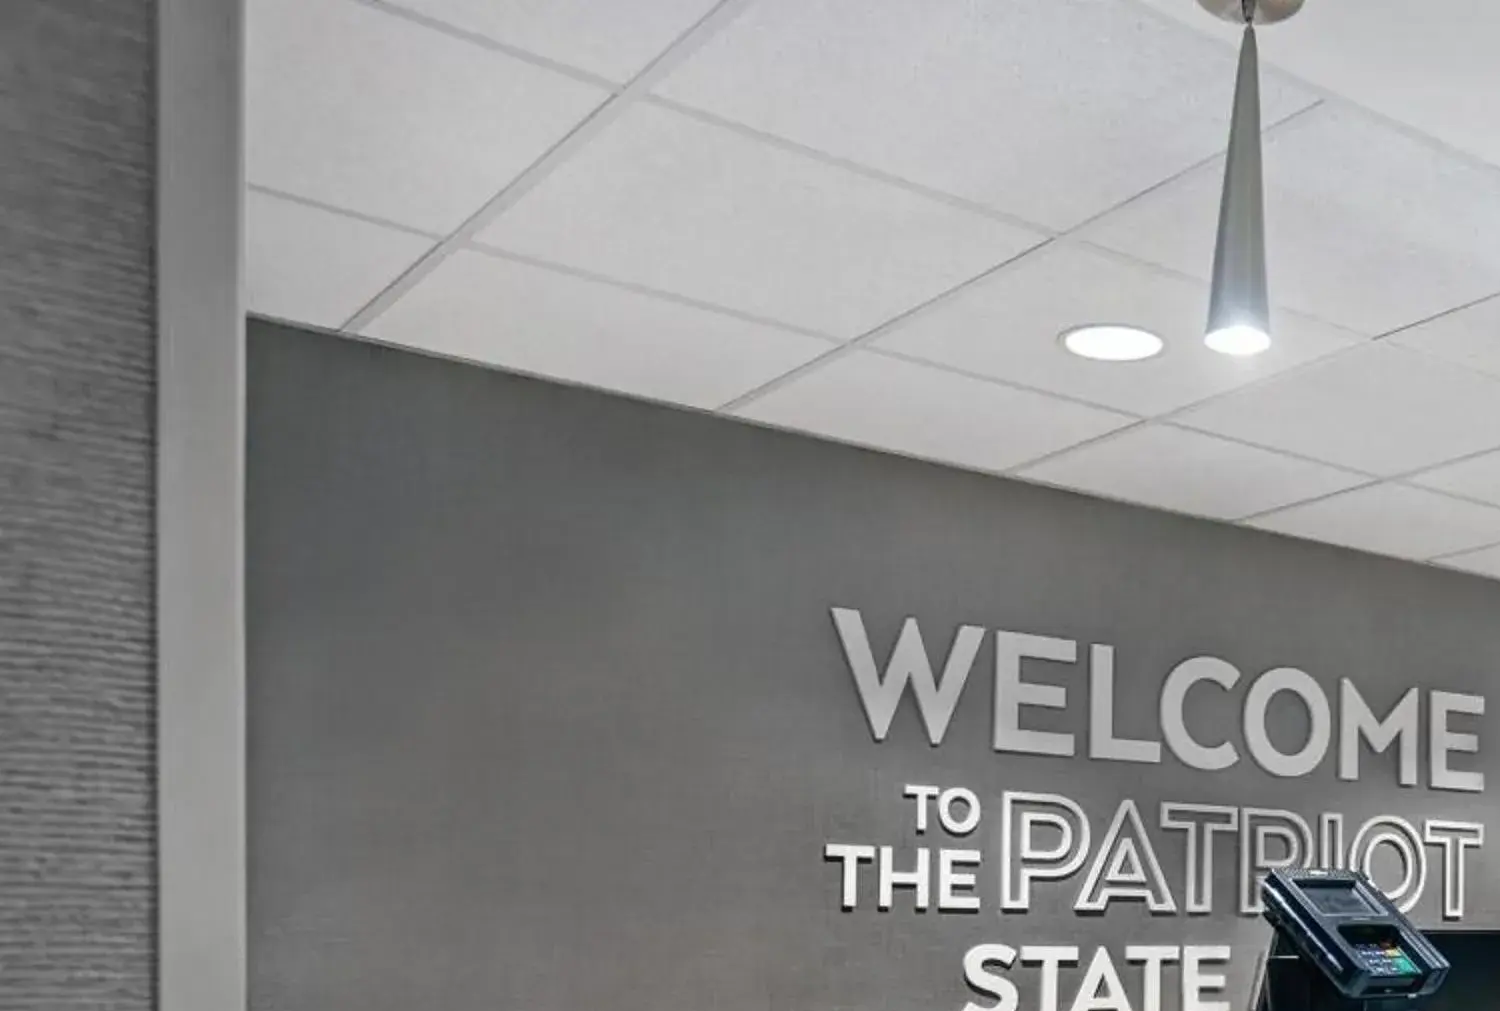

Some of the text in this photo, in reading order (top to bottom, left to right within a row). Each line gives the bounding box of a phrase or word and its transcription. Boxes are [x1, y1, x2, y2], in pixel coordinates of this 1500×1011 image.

[831, 607, 1485, 792] WELCOME
[825, 790, 1485, 918] THE PATRIOT
[904, 784, 981, 834] TO
